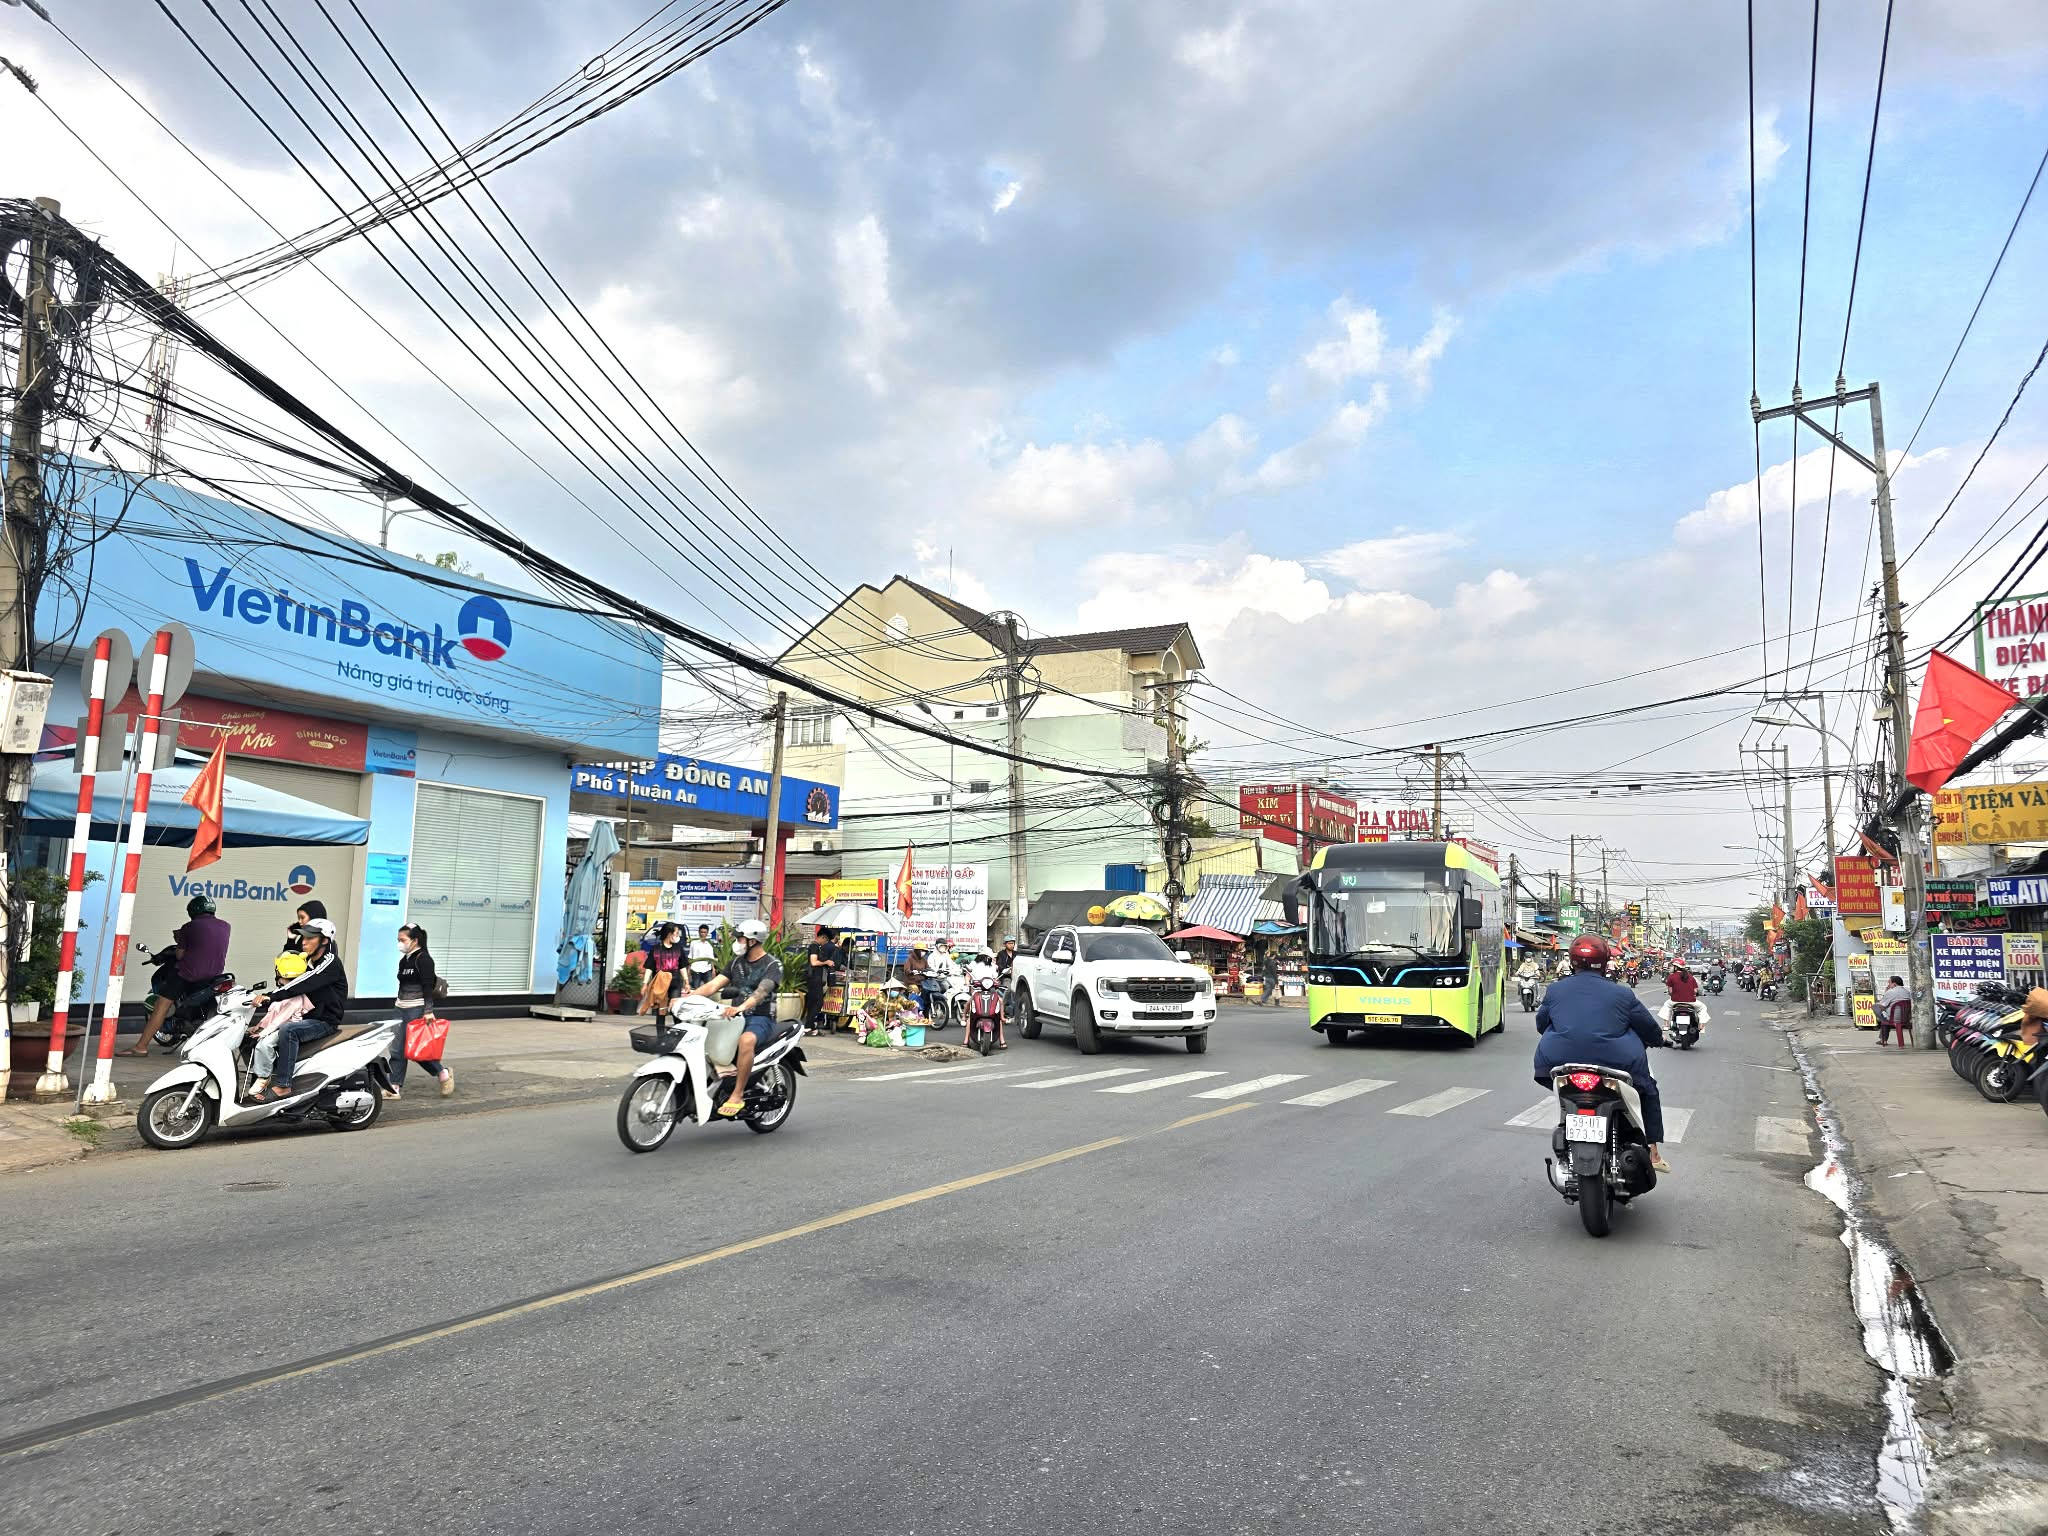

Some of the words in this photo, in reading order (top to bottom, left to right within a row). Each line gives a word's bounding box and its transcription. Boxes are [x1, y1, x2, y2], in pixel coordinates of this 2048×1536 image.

[183, 557, 459, 670] VietinBank
[1996, 638, 2046, 668] ĐIỆN
[337, 660, 384, 689] Nâng
[387, 670, 413, 693] giá
[416, 679, 433, 699] trị
[435, 684, 472, 705] cuộc
[474, 687, 511, 714] sống
[240, 732, 277, 751] Mới
[372, 748, 408, 762] VietinBank
[664, 758, 731, 790] ĐỒNG
[736, 776, 769, 797] AN
[575, 771, 613, 792] Phố
[616, 777, 672, 803] Thuận
[674, 789, 697, 805] An
[1257, 797, 1279, 809] KIM
[1967, 789, 2015, 814] TIỆM
[1385, 808, 1431, 832] KHOA
[1971, 814, 2029, 840] CẦM
[169, 874, 290, 902] VietinBank
[1989, 879, 2012, 892] RÚT
[1947, 935, 1970, 947] BÁN
[1972, 937, 1987, 947] XE
[1936, 948, 1949, 956] XE
[1951, 946, 1973, 957] MÁY
[1975, 948, 2001, 957] 50CC
[1938, 959, 1952, 968] XE
[1954, 959, 1974, 969] ĐẠP
[1976, 957, 2000, 969] ĐIỆN
[2007, 953, 2041, 966] 100K
[1938, 970, 1952, 978] XE
[1953, 969, 1976, 979] MÁY
[1978, 968, 2002, 980] ĐIỆN
[1937, 979, 1952, 991] TRẢ
[1953, 980, 1968, 991] GÓP
[1359, 996, 1412, 1005] VINBUS
[1856, 997, 1873, 1010] SỬA
